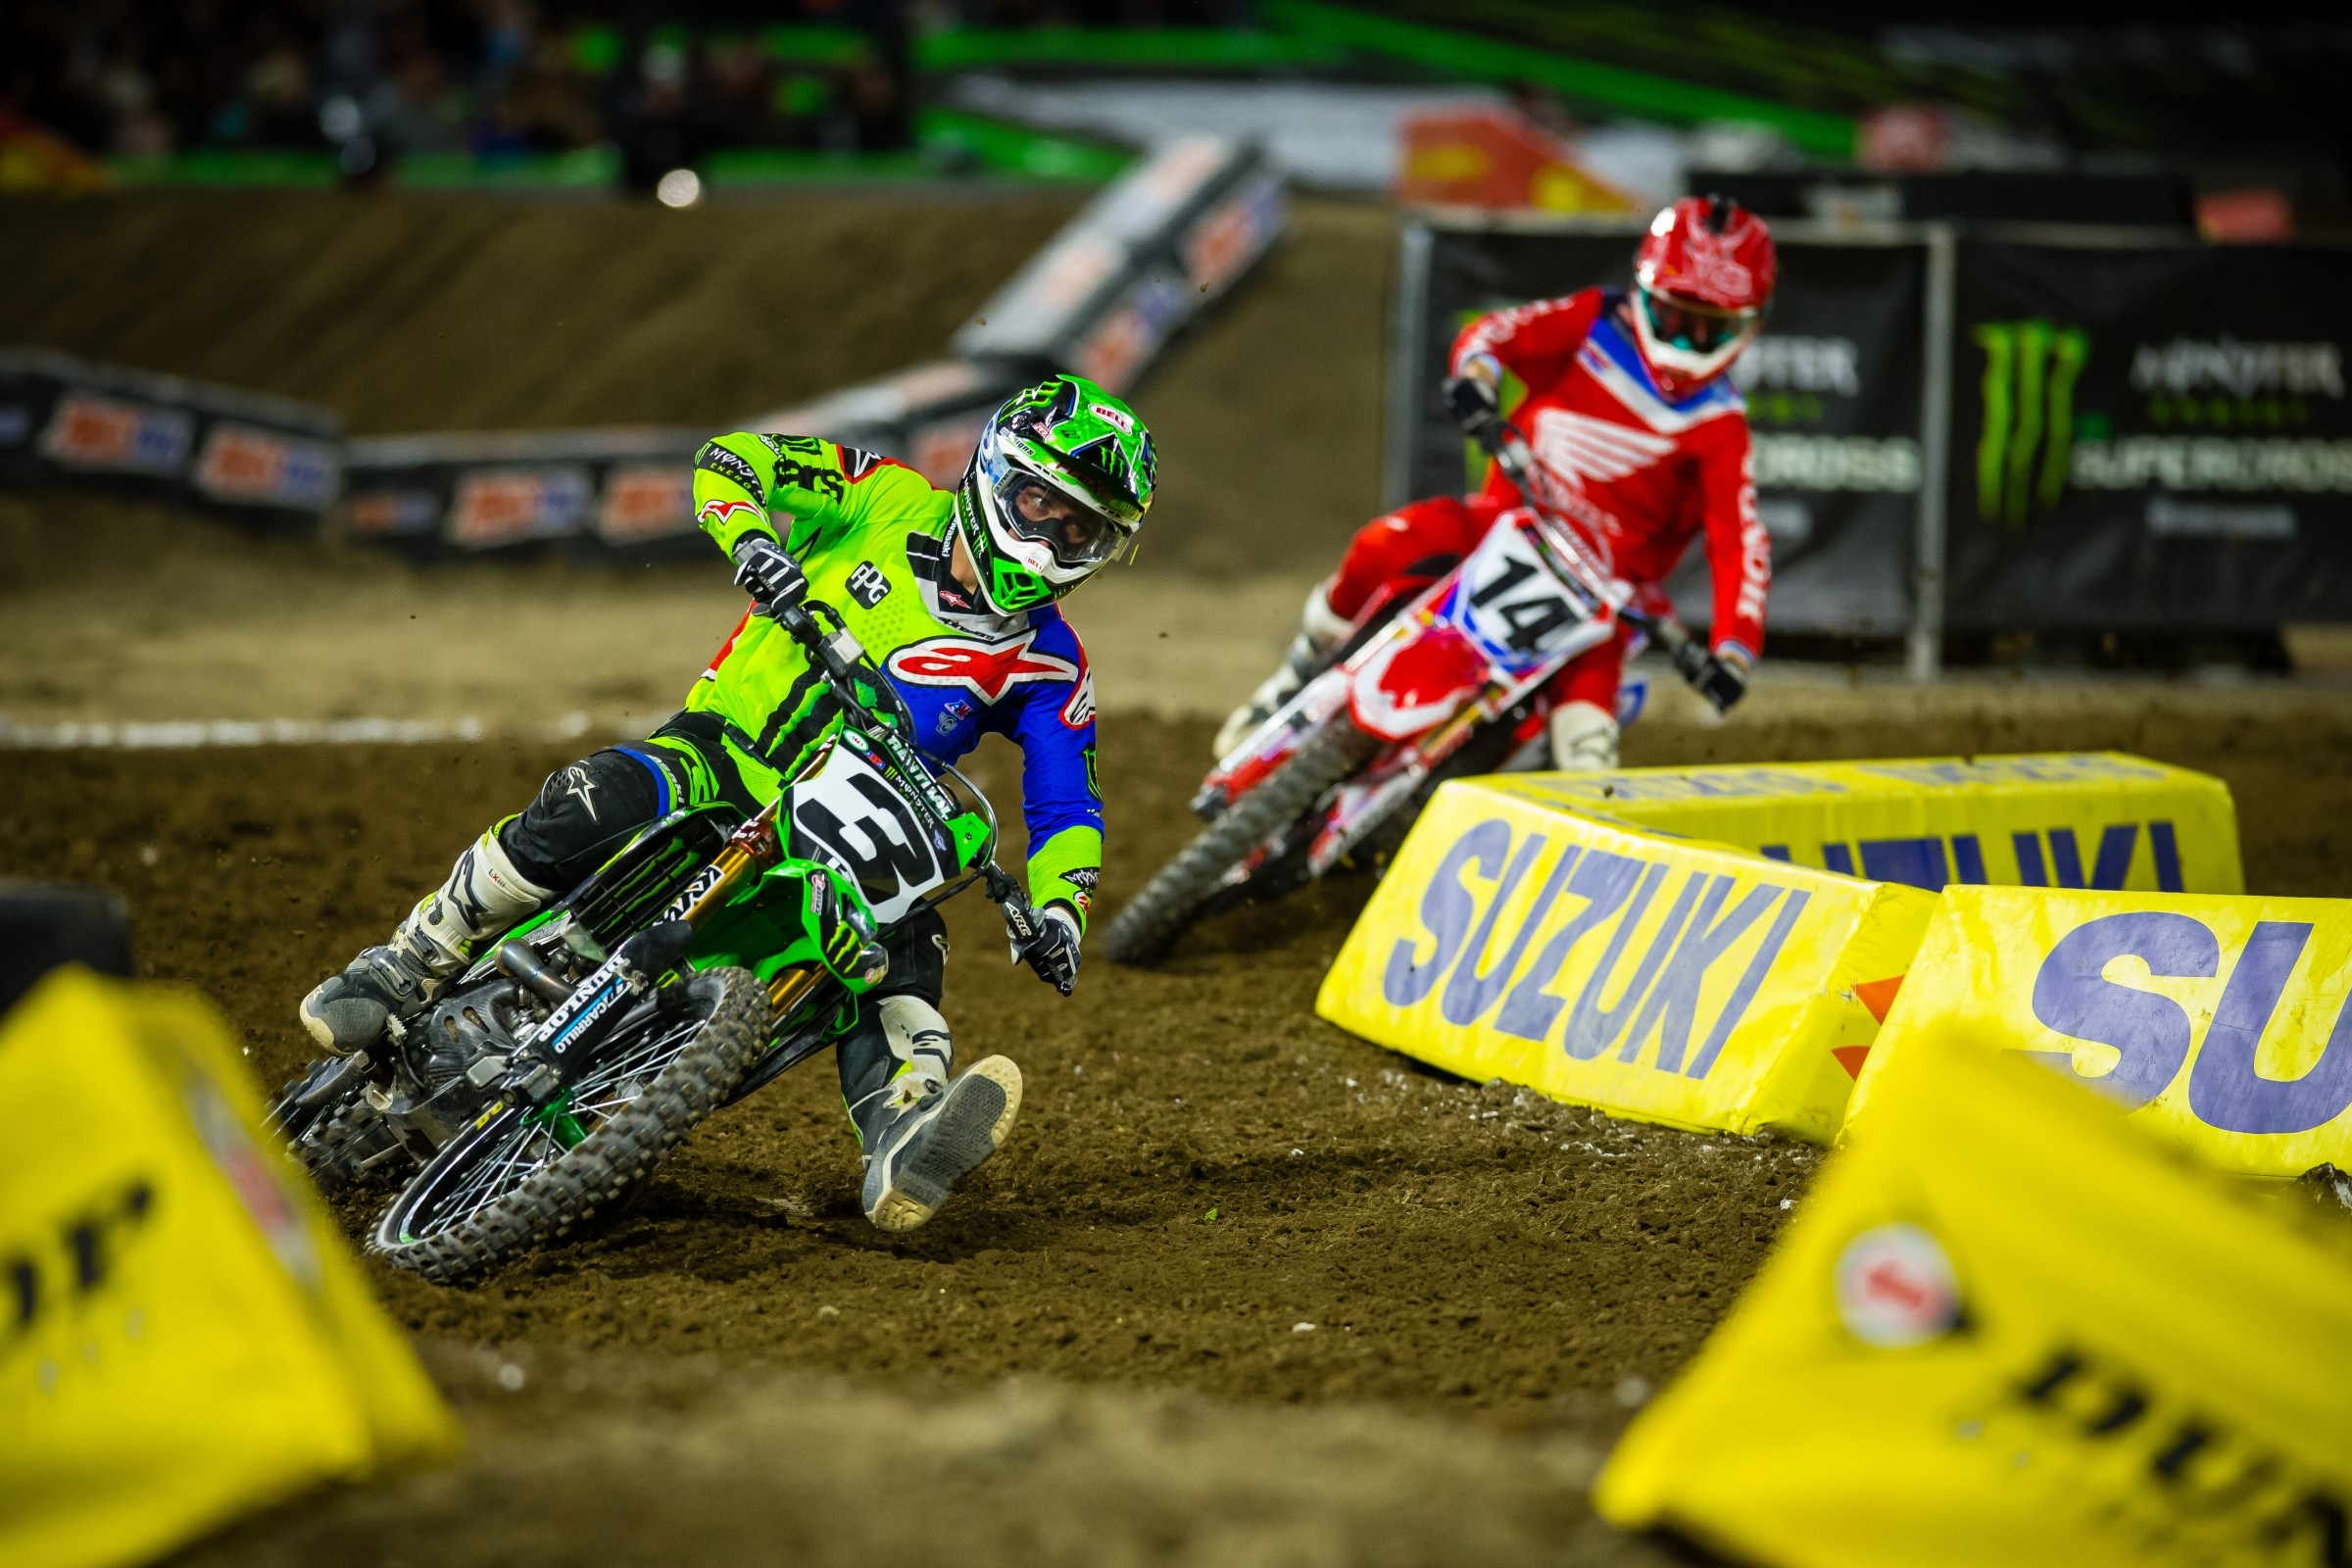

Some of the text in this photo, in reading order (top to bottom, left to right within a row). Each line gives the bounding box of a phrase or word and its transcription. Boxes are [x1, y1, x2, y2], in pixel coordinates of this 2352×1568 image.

[1096, 406, 1127, 430] BELL
[710, 462, 757, 495] ENERG
[851, 564, 889, 605] PPG
[1470, 556, 1581, 652] 14
[895, 774, 935, 829] MONSTER
[793, 771, 936, 908] 3
[1004, 901, 1032, 937] ARC
[1383, 818, 1812, 1080] SUZUKI
[537, 954, 629, 1043] DUNLOP
[554, 1000, 608, 1054] CARRILLO
